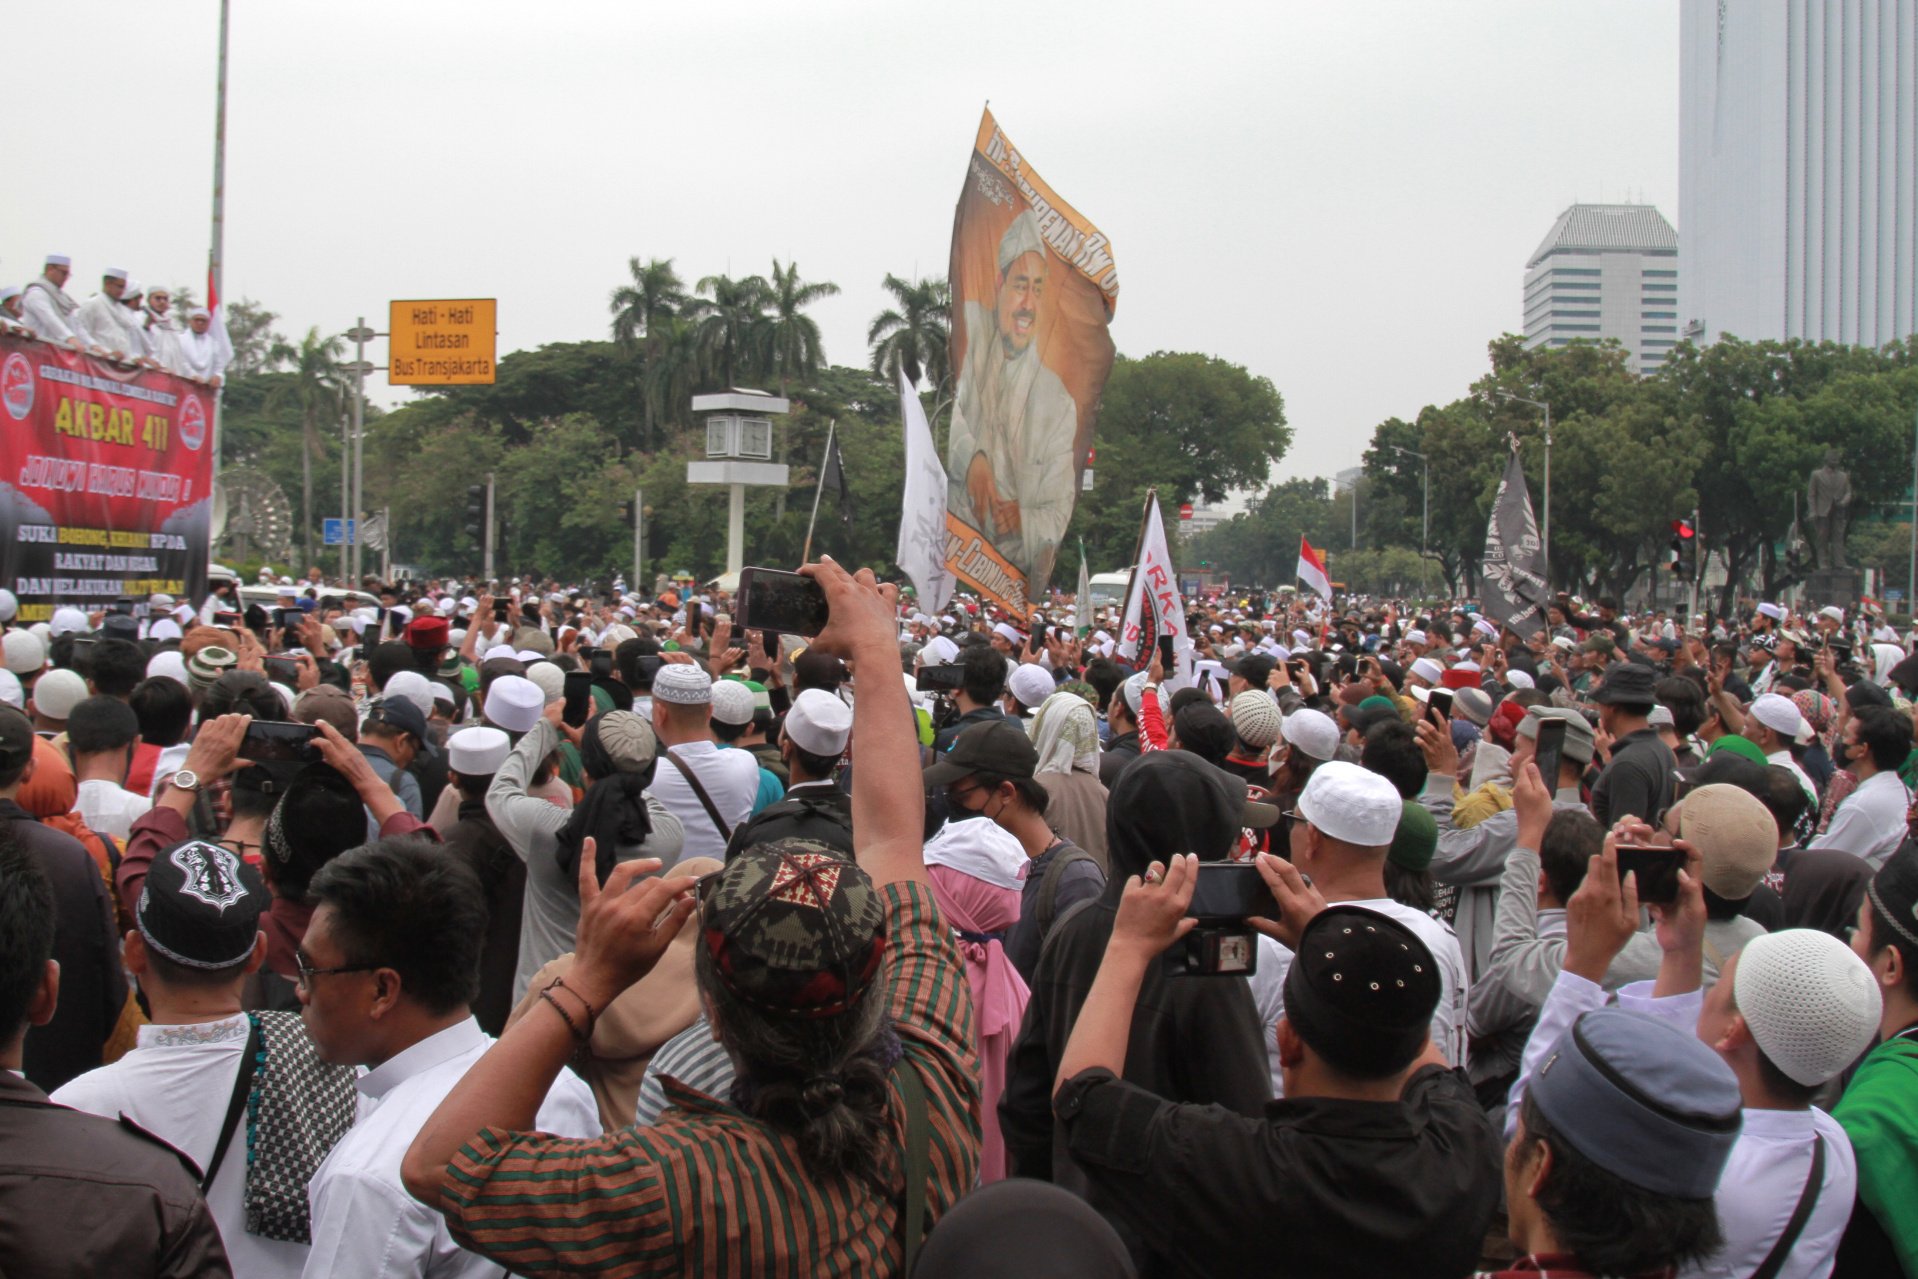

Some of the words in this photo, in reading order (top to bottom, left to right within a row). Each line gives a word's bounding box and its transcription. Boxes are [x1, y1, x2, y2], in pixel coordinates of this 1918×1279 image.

[412, 306, 437, 325] Hati
[448, 305, 474, 325] Hati
[416, 332, 469, 349] Lintasan
[395, 358, 414, 376] Bus
[416, 357, 489, 380] Transjakarta
[55, 397, 134, 446] AKBAR
[142, 414, 168, 451] 411
[17, 525, 57, 543] SUKA
[54, 553, 104, 570] RAKYAT
[16, 578, 52, 595] DAN
